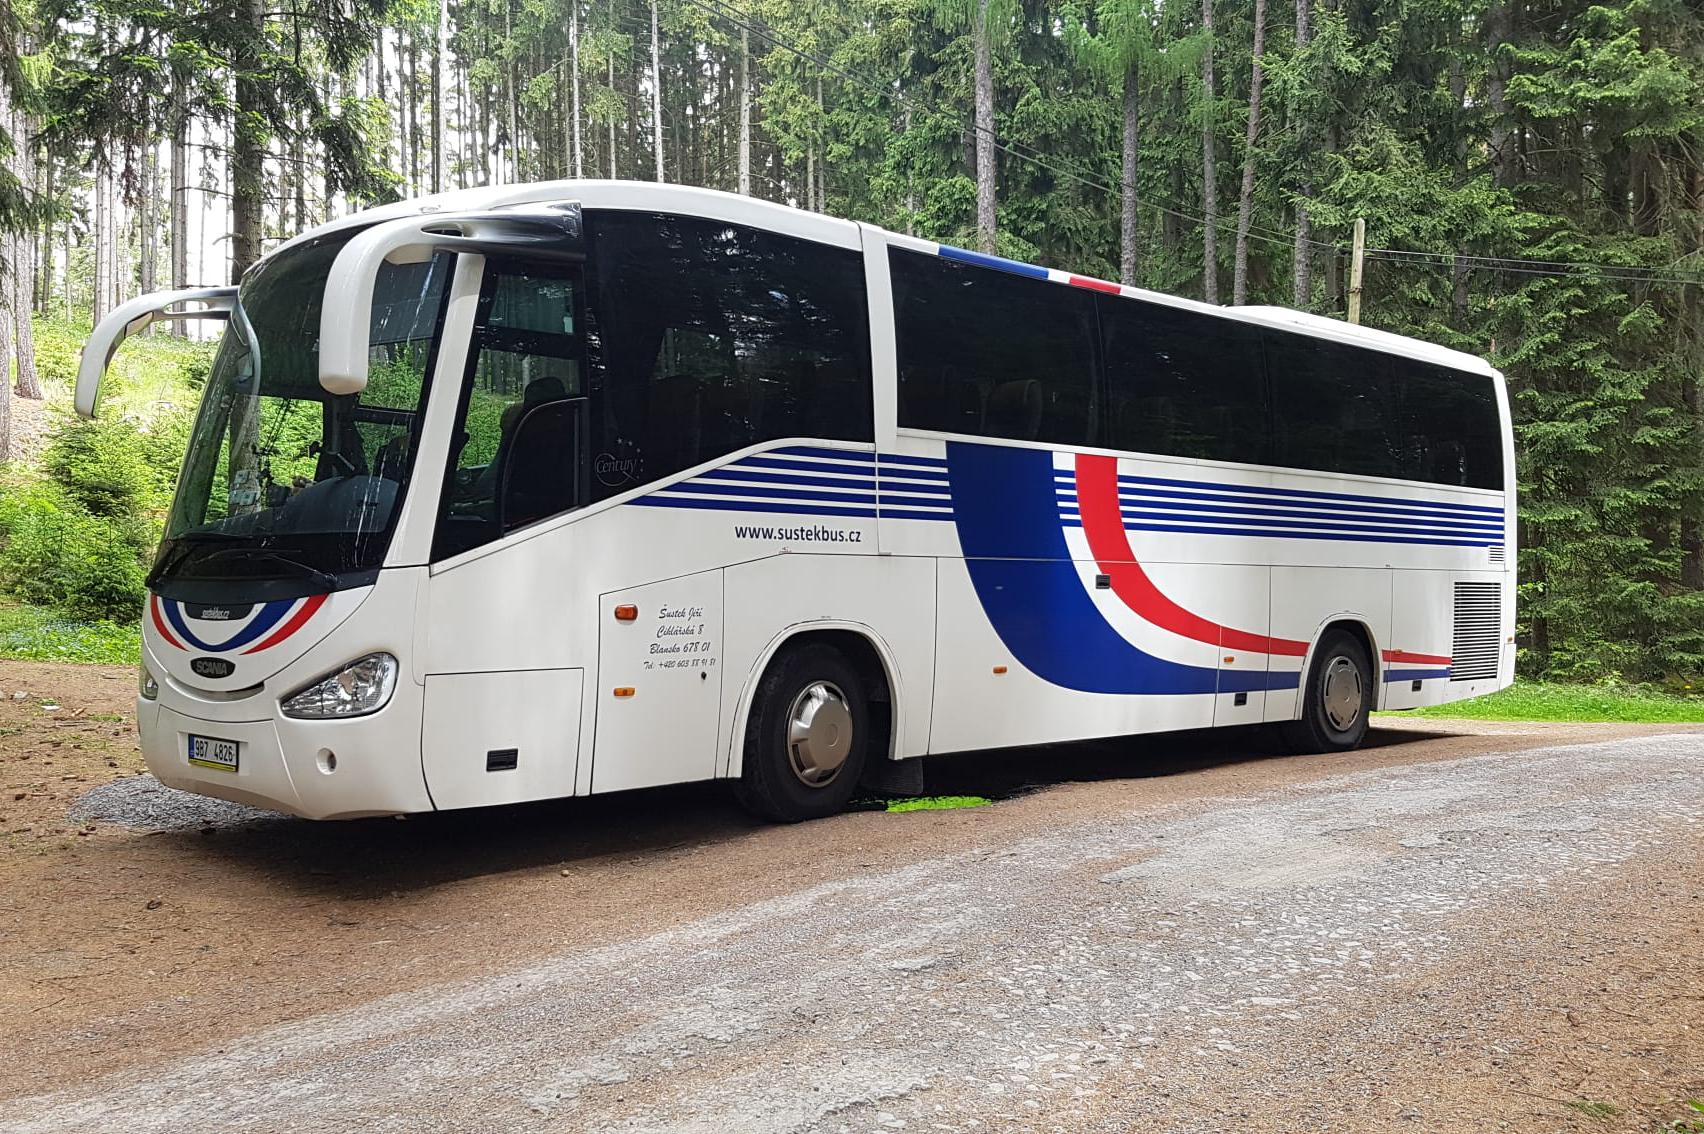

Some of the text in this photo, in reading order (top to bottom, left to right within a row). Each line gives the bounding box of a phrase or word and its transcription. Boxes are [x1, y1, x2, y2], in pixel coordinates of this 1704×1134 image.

[735, 525, 861, 542] www.sustekbus.cz
[659, 604, 703, 621] Šustek Jiří
[649, 641, 711, 654] Blansko 678 01
[196, 660, 228, 675] SCANIA
[195, 739, 233, 762] 9B7 4826
